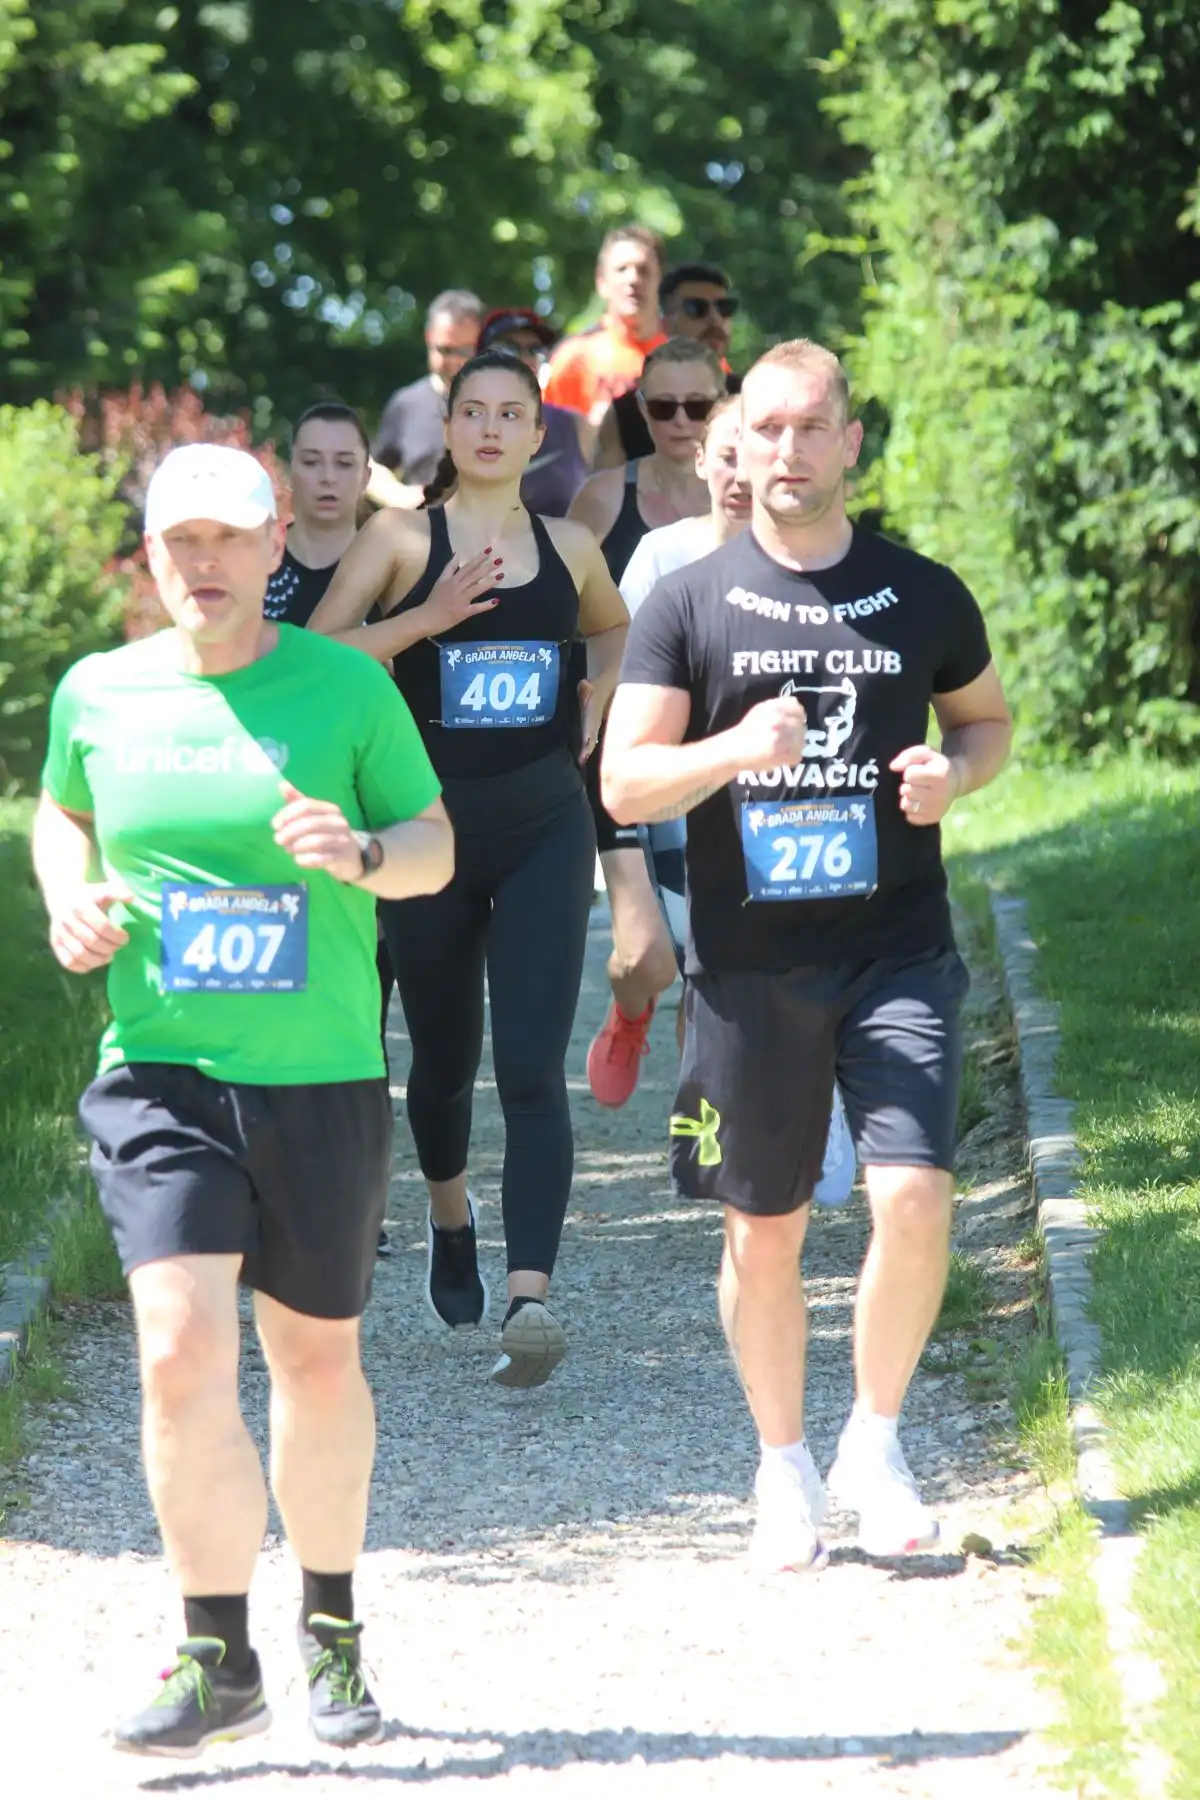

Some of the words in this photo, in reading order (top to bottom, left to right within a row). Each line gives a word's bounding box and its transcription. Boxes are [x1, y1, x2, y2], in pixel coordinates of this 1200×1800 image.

[726, 586, 791, 622] BORN
[795, 604, 829, 625] TO
[831, 587, 899, 623] FIGHT
[465, 650, 497, 664] GRADA
[732, 650, 819, 676] FIGHT
[825, 650, 902, 674] CLUB
[460, 672, 541, 711] 404
[116, 736, 237, 775] unicef
[737, 758, 880, 788] KOVAČIĆ
[767, 811, 803, 828] GRADA
[769, 832, 852, 882] 276
[182, 924, 287, 974] 407
